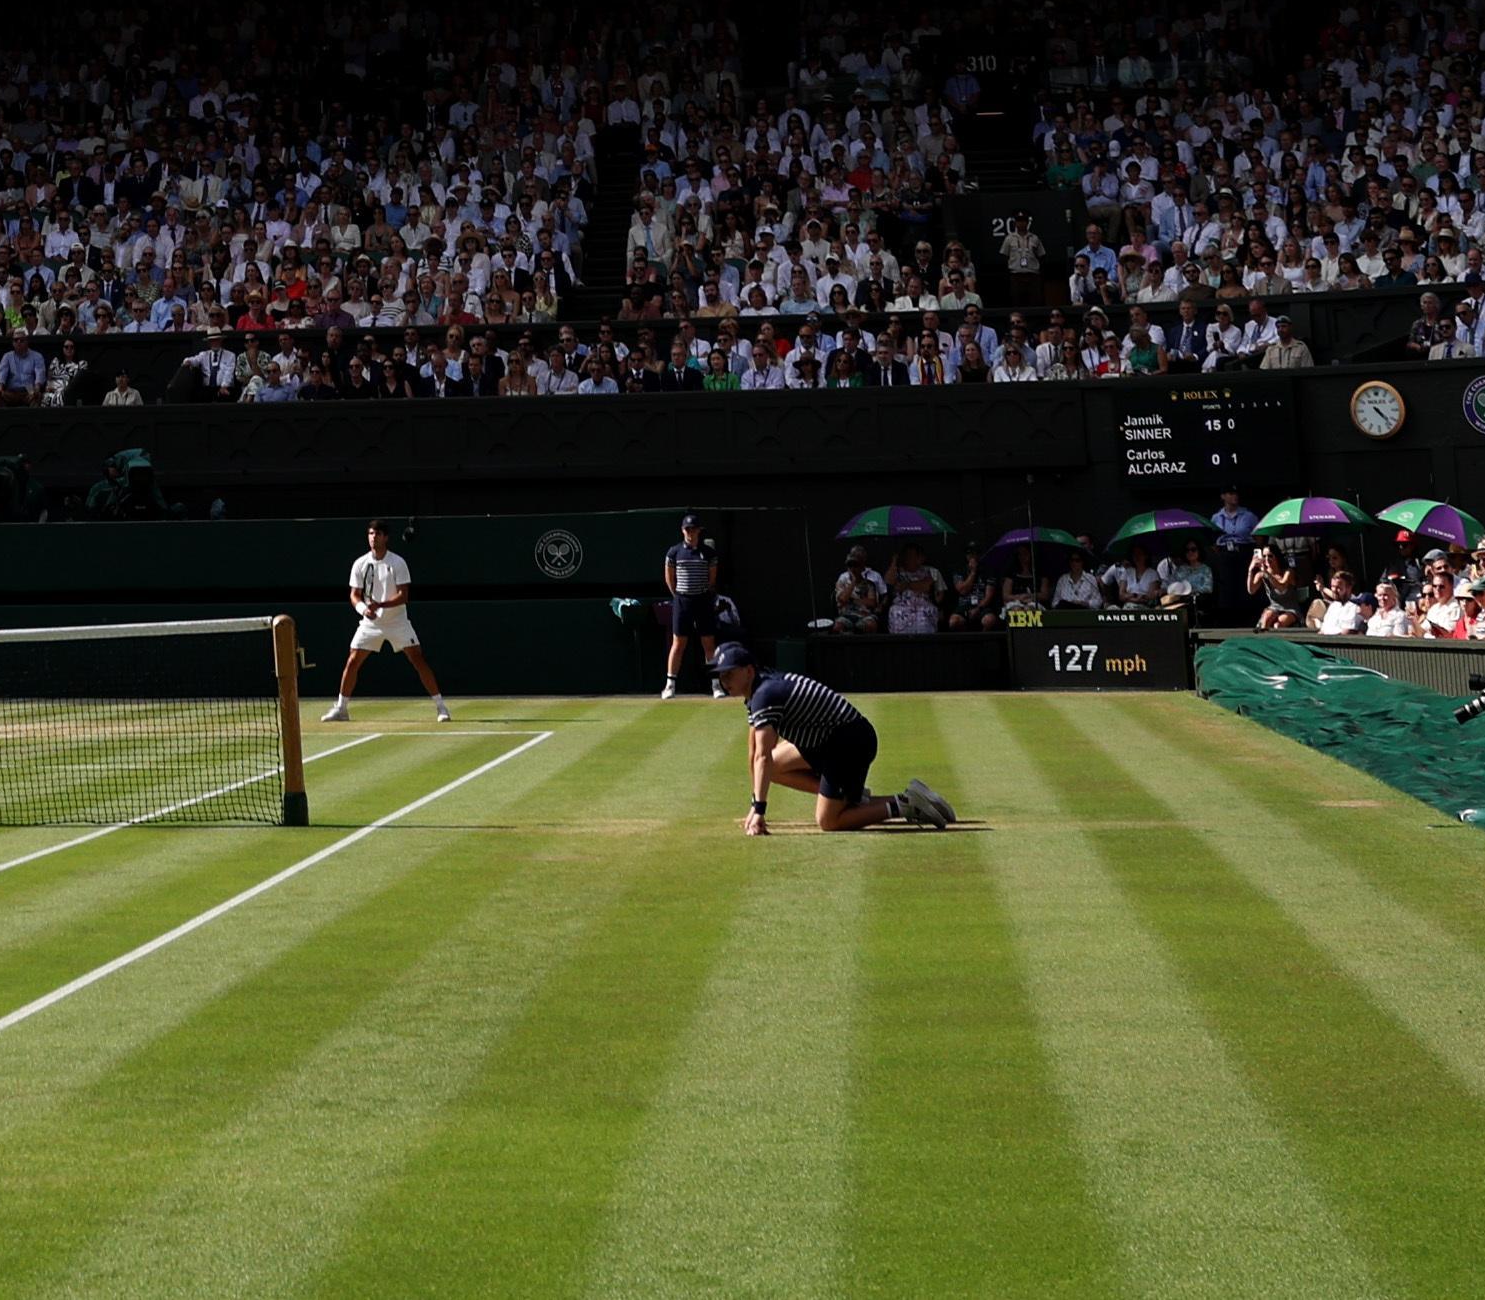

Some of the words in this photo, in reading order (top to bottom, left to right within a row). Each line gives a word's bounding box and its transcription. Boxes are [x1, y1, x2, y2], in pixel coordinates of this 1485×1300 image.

[966, 55, 997, 72] 310
[1183, 390, 1218, 400] ROLEX
[1123, 414, 1165, 427] Jannik
[1124, 427, 1173, 441] SINNER
[1205, 419, 1222, 431] 15
[1227, 418, 1235, 430] 0
[1126, 448, 1166, 461] Carlos
[1127, 461, 1187, 475] ALCARAZ
[1211, 453, 1221, 466] 0
[1231, 452, 1238, 464] 1
[1008, 610, 1043, 627] IBM
[1097, 614, 1135, 622] RANGE
[1140, 614, 1178, 622] ROVER
[1048, 644, 1098, 672] 127
[1105, 653, 1147, 676] mph
